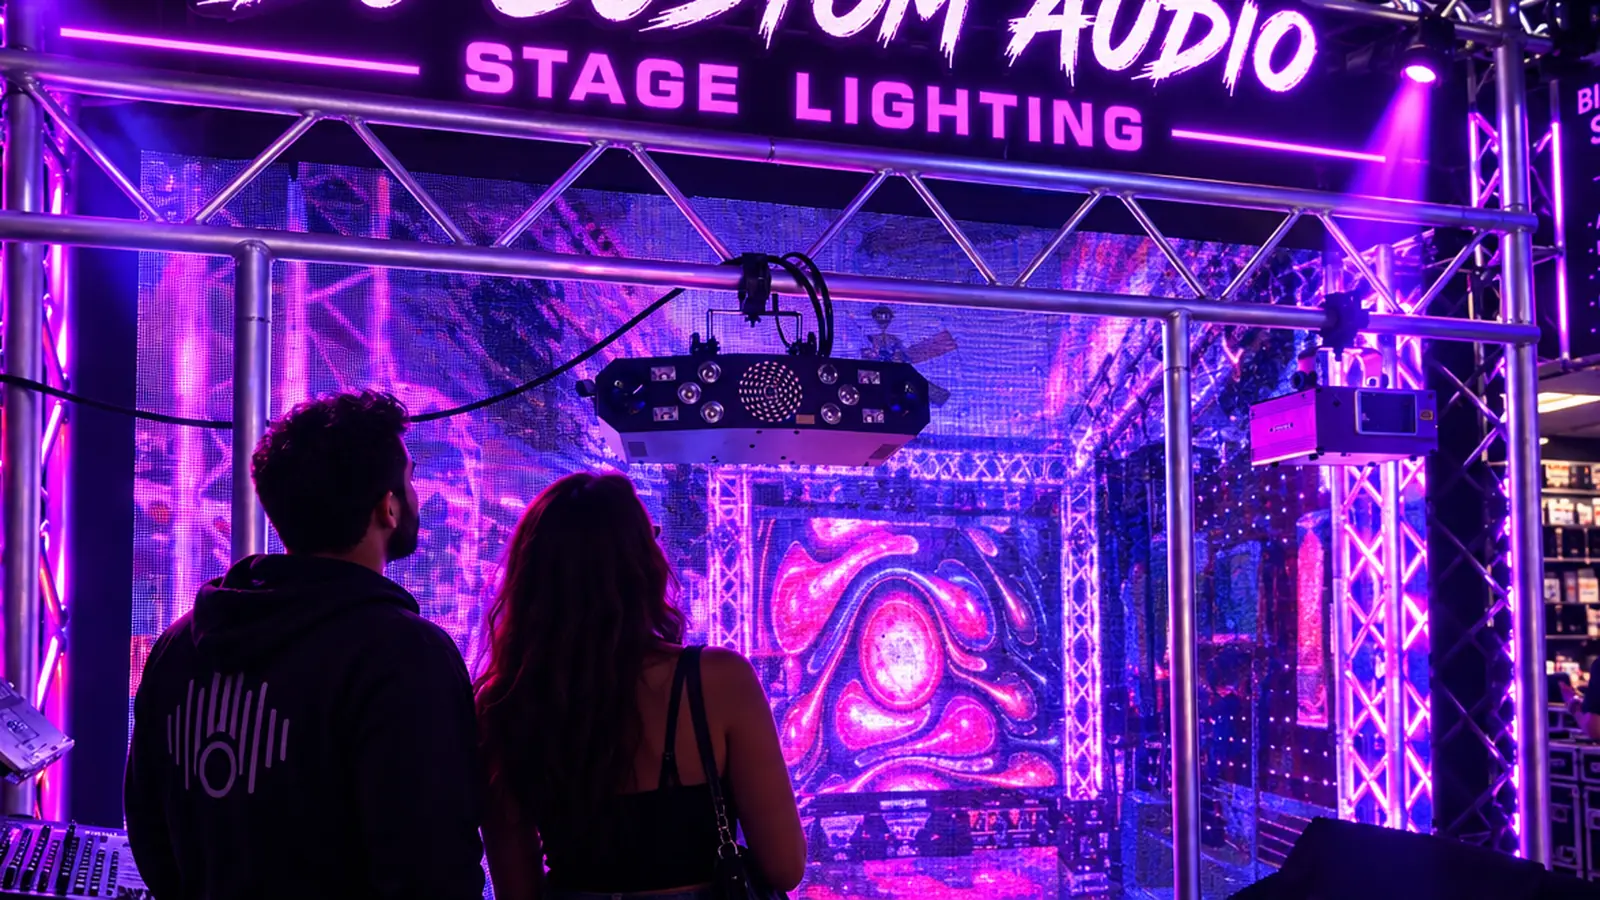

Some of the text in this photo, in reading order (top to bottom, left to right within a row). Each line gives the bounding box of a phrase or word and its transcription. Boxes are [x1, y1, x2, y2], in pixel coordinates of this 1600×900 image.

[465, 41, 1143, 152] STAGE LIGHTING
[492, 0, 1316, 96] TOM AUDIO
